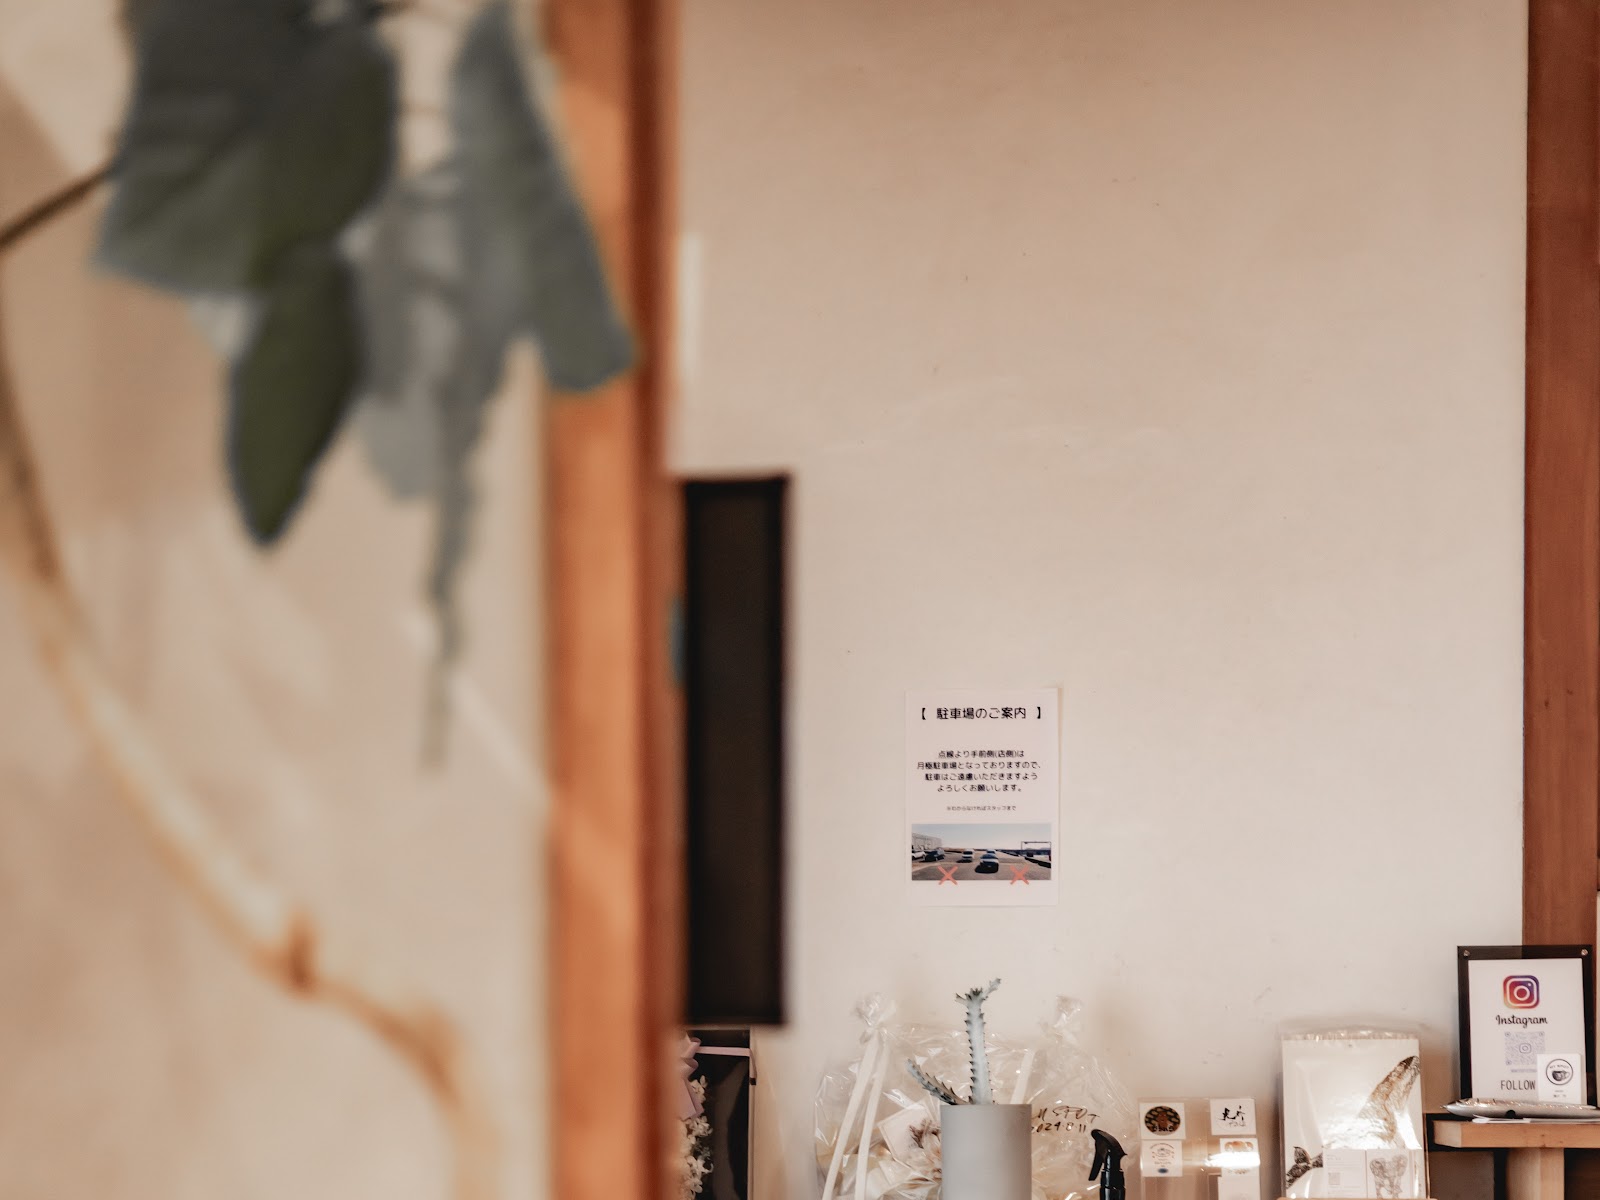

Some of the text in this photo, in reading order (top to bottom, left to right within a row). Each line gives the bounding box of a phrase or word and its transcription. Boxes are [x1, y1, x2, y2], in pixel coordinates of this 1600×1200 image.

[925, 772, 1038, 781] 駐車はご遠慮いただきますよう
[937, 784, 1022, 792] よろしくお願いします。
[1495, 1014, 1548, 1029] Instagram
[1500, 1080, 1536, 1090] FOLLOW
